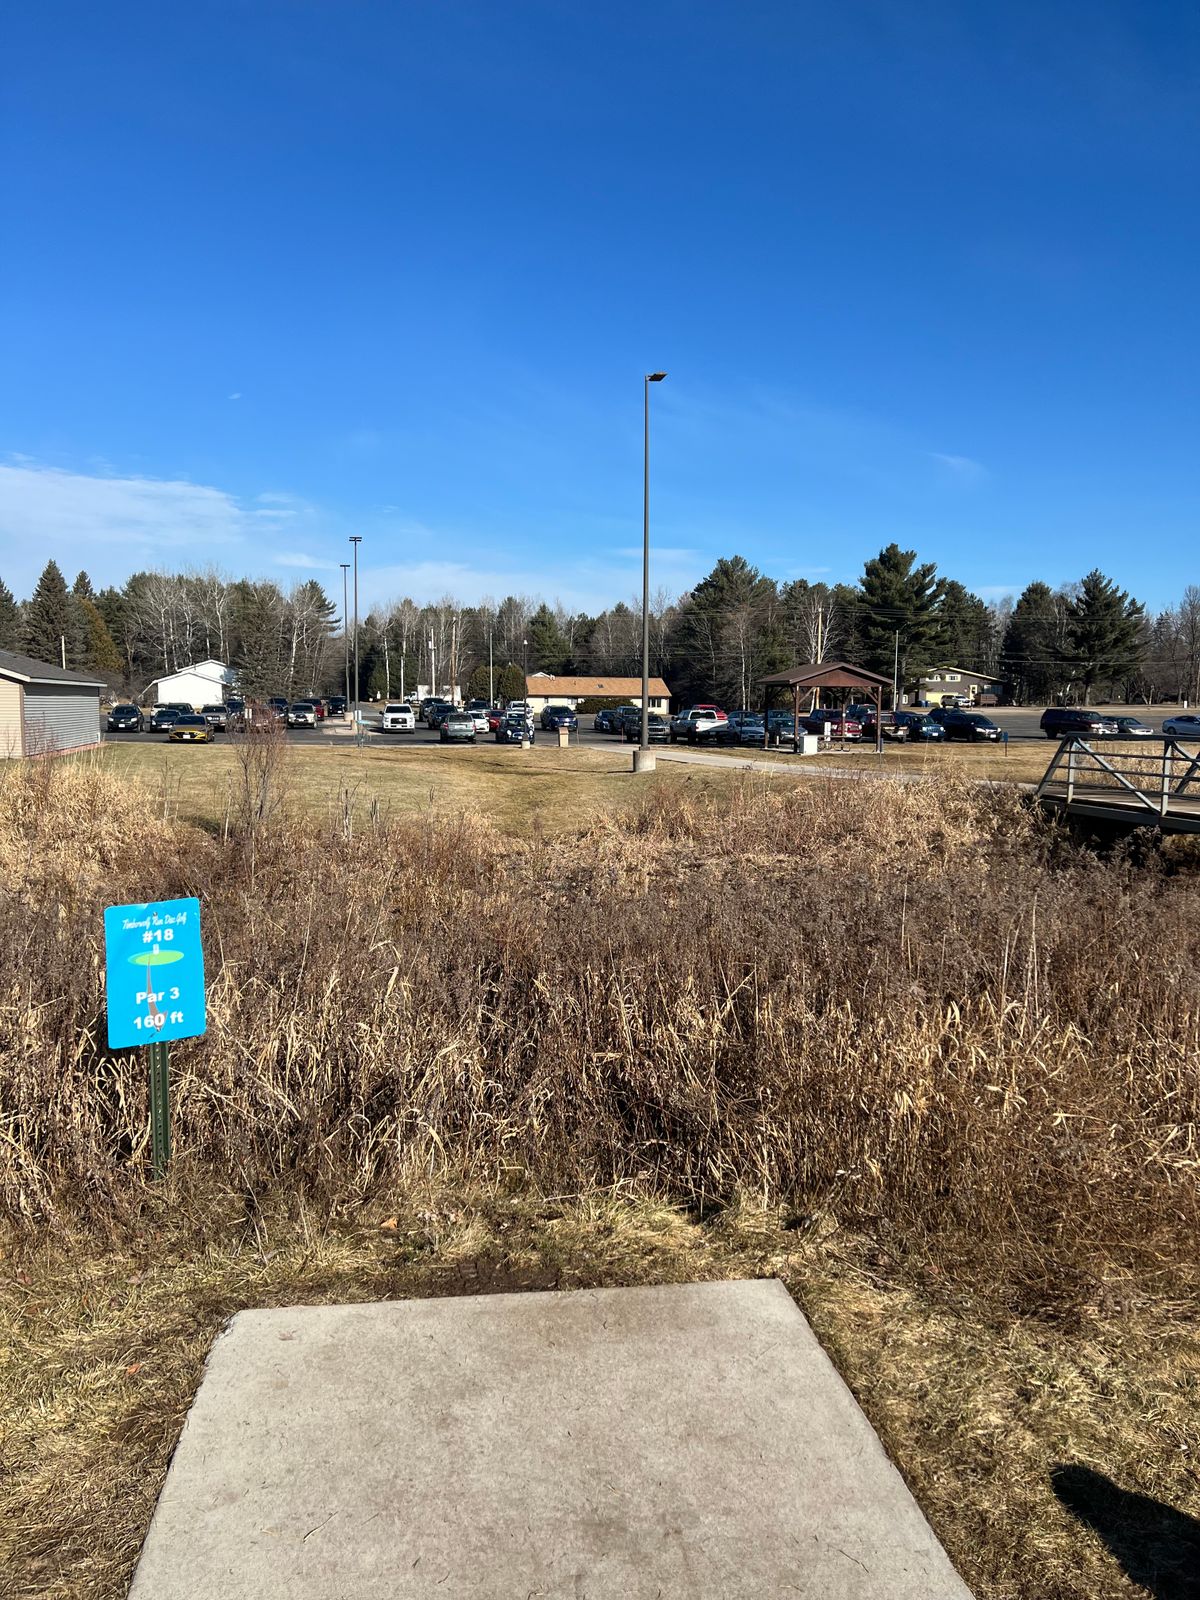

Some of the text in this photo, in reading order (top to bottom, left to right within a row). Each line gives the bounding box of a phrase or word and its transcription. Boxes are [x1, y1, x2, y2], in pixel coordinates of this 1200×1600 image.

[142, 929, 174, 943] #18
[136, 987, 180, 1005] Par 3
[133, 1010, 184, 1030] 160 ft
